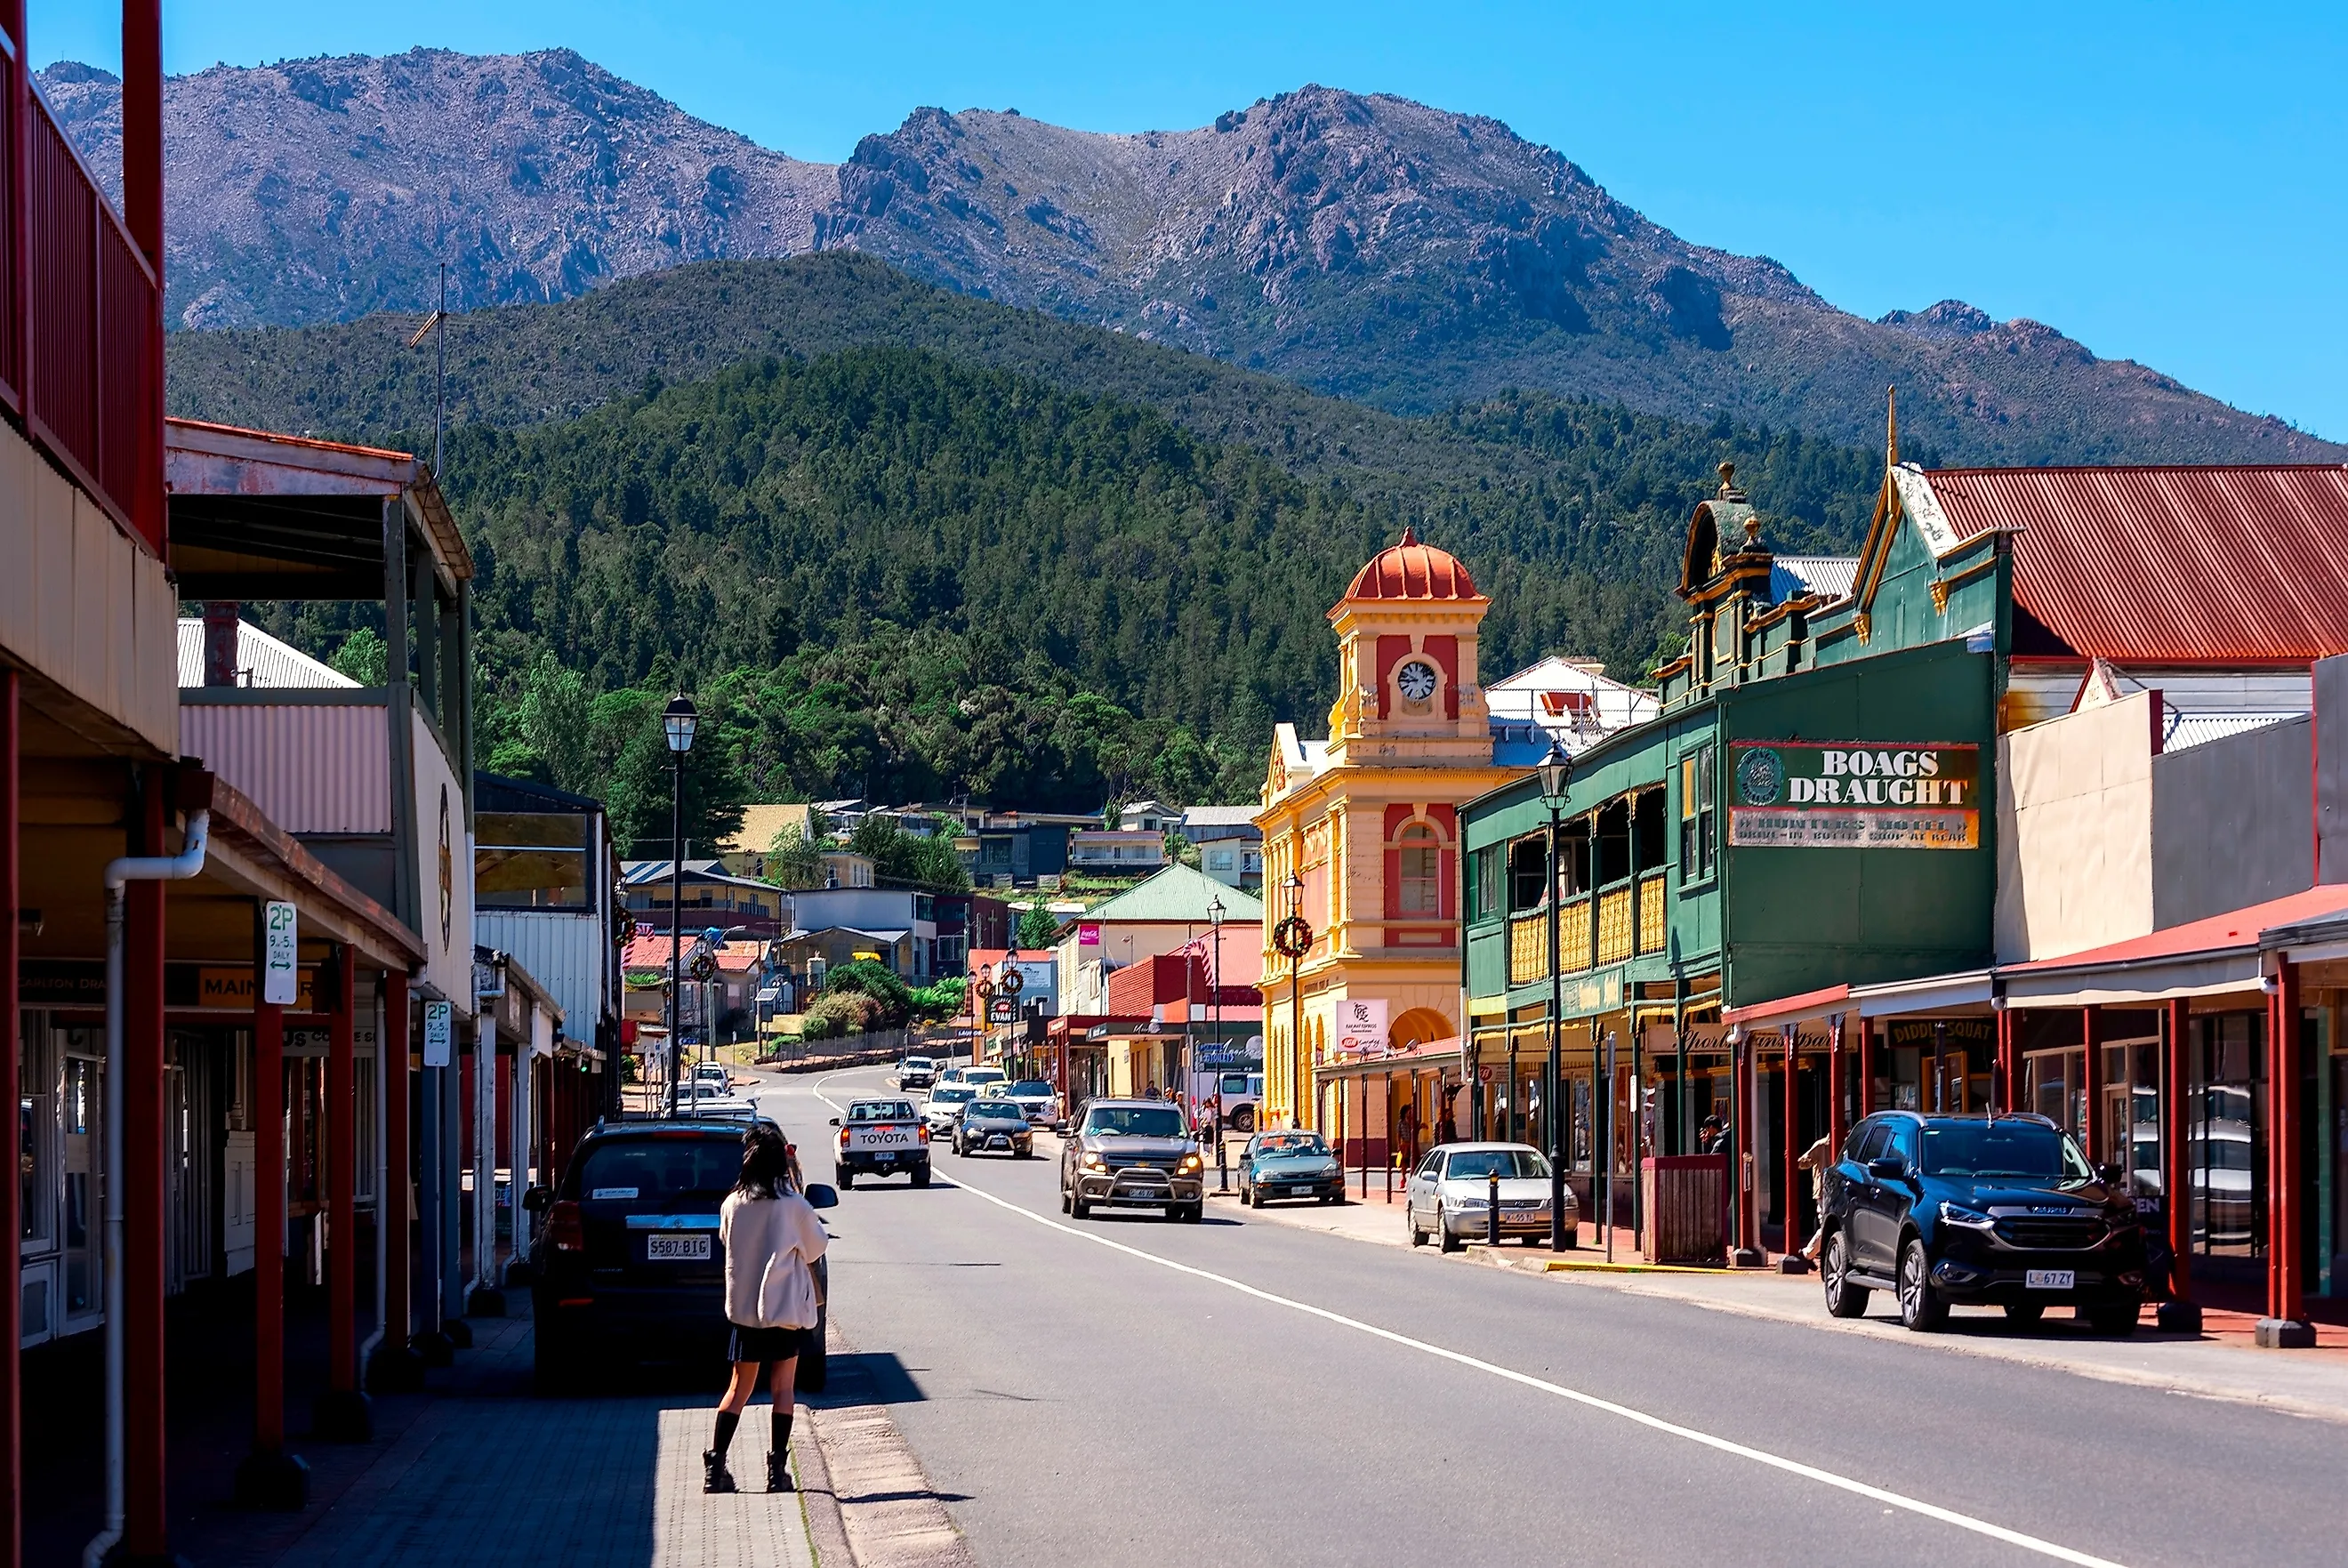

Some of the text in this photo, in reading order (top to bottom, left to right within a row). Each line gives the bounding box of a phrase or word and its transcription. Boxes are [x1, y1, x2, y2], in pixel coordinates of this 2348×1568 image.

[1821, 750, 1939, 777] BOAGS
[1788, 777, 1969, 805] DRAUGHT
[269, 905, 294, 931] 2P
[273, 951, 290, 960] DAILY
[18, 977, 74, 989] CARLTON
[428, 1004, 448, 1020] 2P
[1892, 1021, 1993, 1042] DIDDL SQUAT
[860, 1131, 909, 1145] TOYOTA
